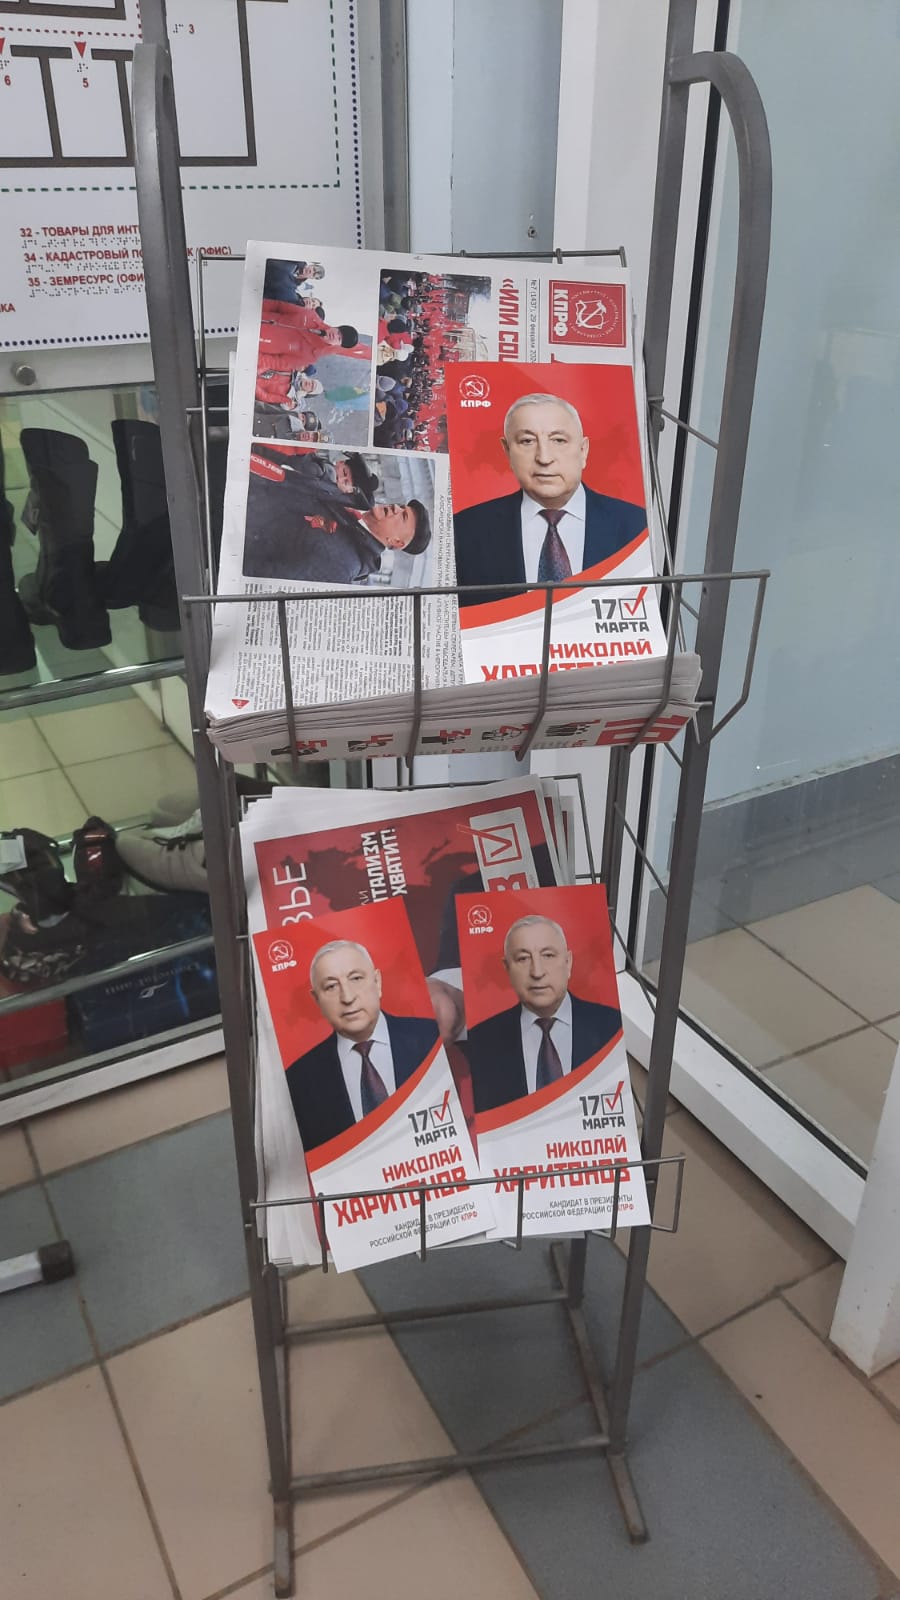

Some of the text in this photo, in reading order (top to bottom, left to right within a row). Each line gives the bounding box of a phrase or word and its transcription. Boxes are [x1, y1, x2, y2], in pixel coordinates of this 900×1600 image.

[188, 24, 195, 34] 3
[4, 75, 11, 86] 6
[82, 78, 89, 88] 5
[20, 228, 32, 237] 32
[42, 227, 89, 237] ТОВАРЫ
[92, 226, 115, 237] ДЛЯ
[24, 253, 36, 262] 34
[46, 248, 129, 262] КАДАСТРОВЫЙ
[28, 277, 41, 287] 35
[49, 274, 114, 286] ЗЕМРЕСУРС
[0, 303, 16, 313] КА
[499, 278, 519, 326] «ИЛИ
[553, 289, 569, 337] КПРФ
[461, 400, 492, 408] КПРФ
[591, 599, 617, 620] 17
[595, 621, 650, 634] МАРТА
[549, 638, 653, 660] НИКОЛАЙ
[381, 827, 408, 897] ХВАТИТ!
[469, 926, 494, 935] КПРФ
[272, 960, 298, 973] КПРФ
[579, 1095, 601, 1116] 17
[408, 1109, 428, 1133] 17
[582, 1116, 626, 1130] МАРТА
[414, 1125, 458, 1147] МАРТА
[546, 1134, 627, 1159] НИКОЛАЙ
[382, 1144, 463, 1183] НИКОЛАЙ
[493, 1157, 631, 1193] ХАРИТОНОВ
[333, 1166, 471, 1227] ХАРИТОНОВ
[550, 1198, 583, 1209] КАНДИДАТ
[590, 1194, 633, 1205] ПРЕЗИДНТЫ
[394, 1201, 476, 1232] КАНДИД В ПРЕЗИДЕНТЫ
[522, 1209, 566, 1220] РОССИЙСКОЙ
[567, 1204, 606, 1216] ФЕДЕРАЦИИ
[369, 1210, 479, 1249] РОССИЙСКОЙ ФЕЕРАЦИИ ОТ КПРФ
